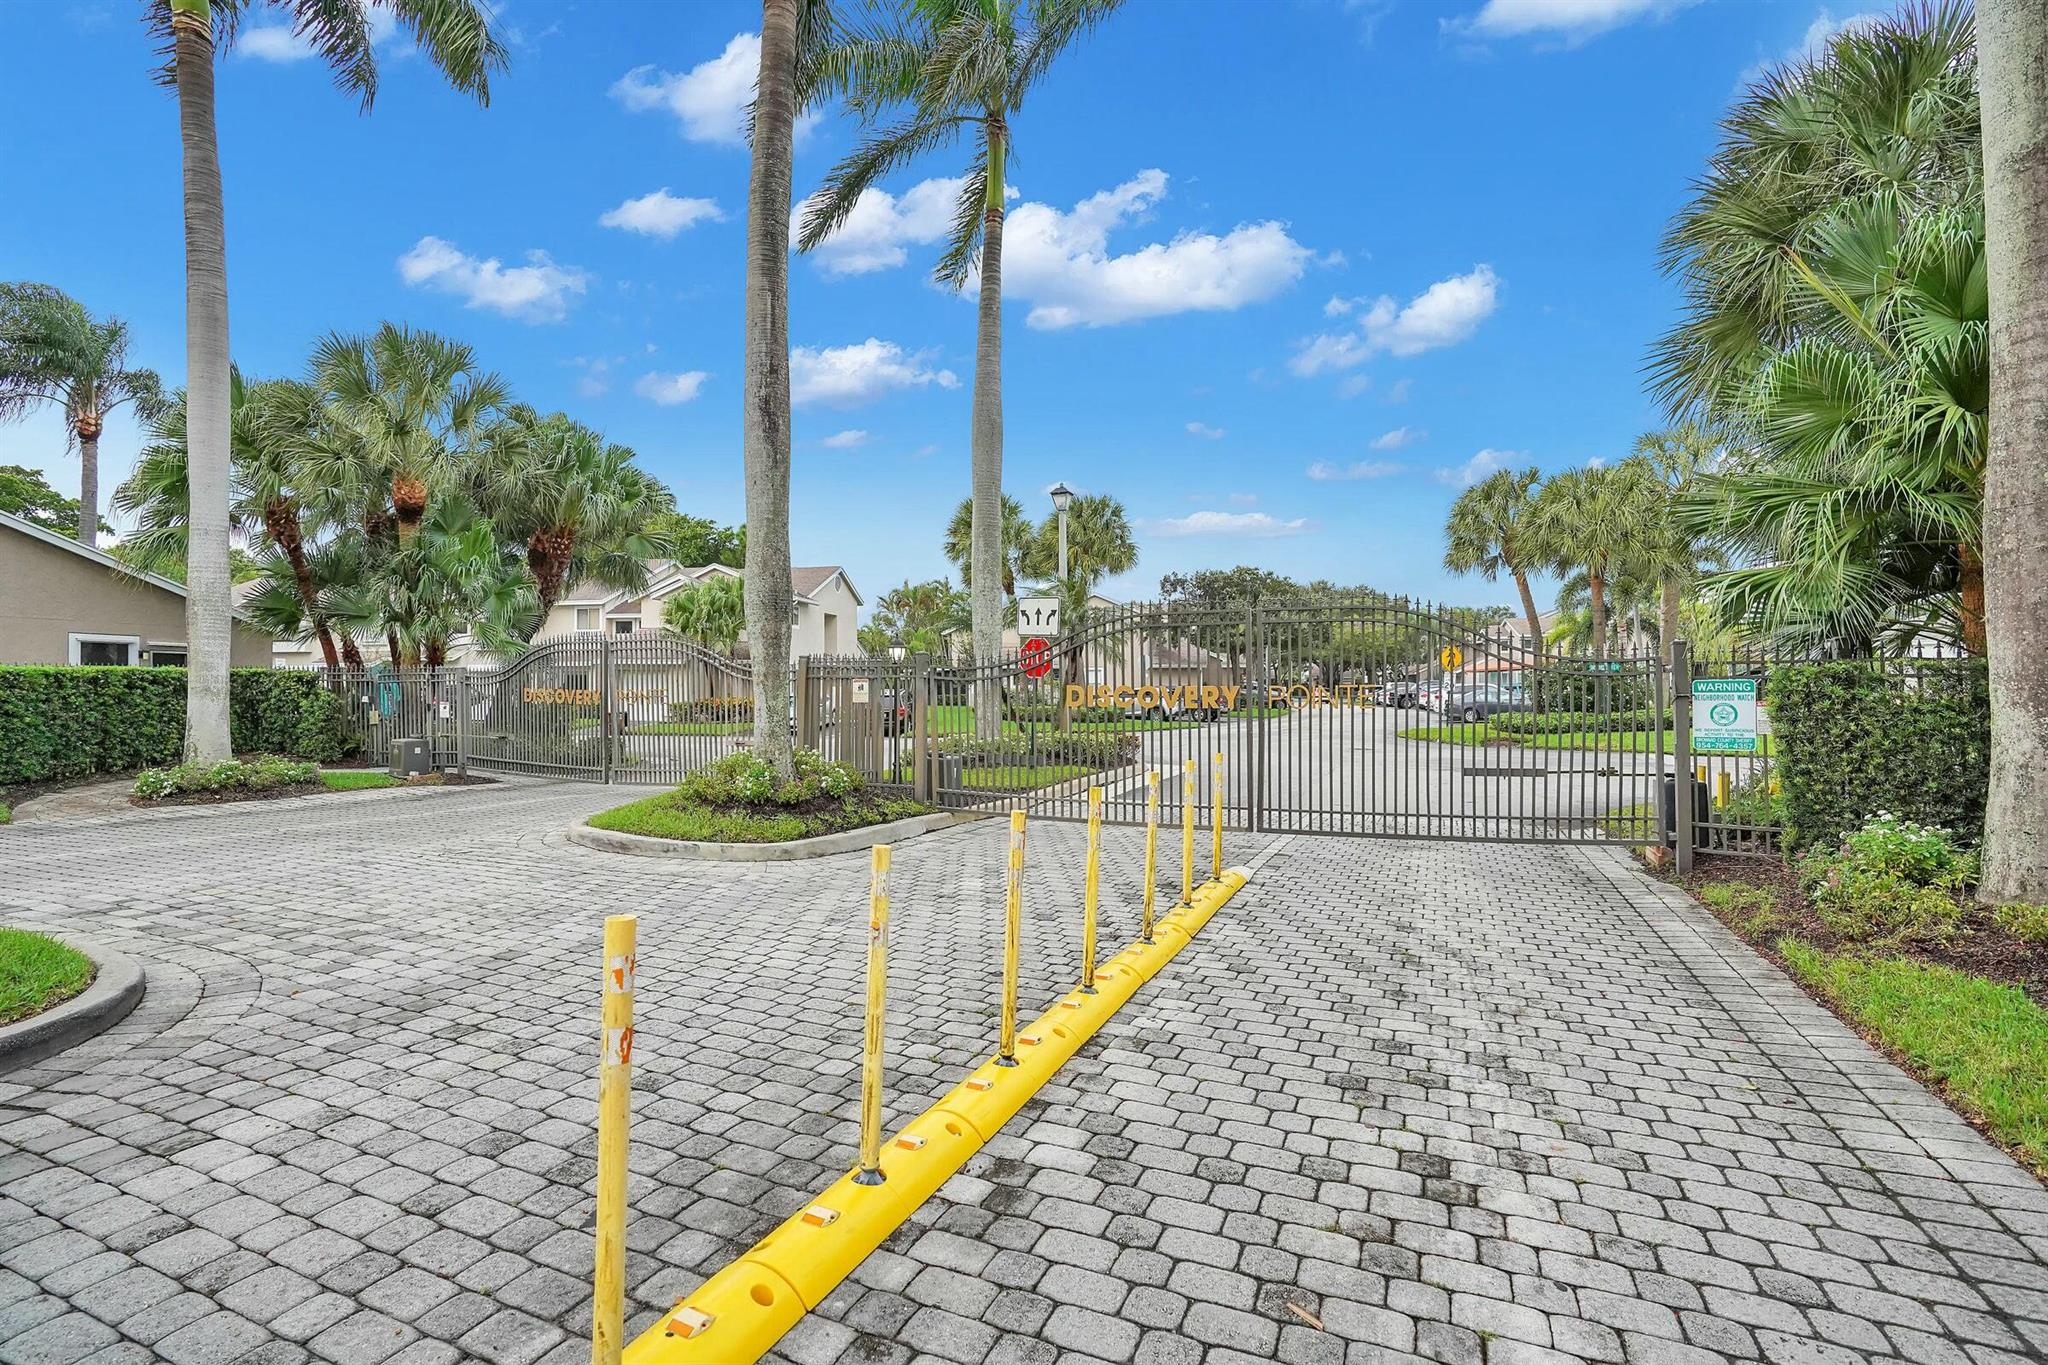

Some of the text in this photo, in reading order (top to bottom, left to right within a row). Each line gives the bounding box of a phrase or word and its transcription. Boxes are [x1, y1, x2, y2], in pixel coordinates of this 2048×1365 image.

[1697, 682, 1751, 691] WARNING
[523, 687, 601, 705] DISCOVERY
[1066, 684, 1376, 710] DISCOVERY POINTE
